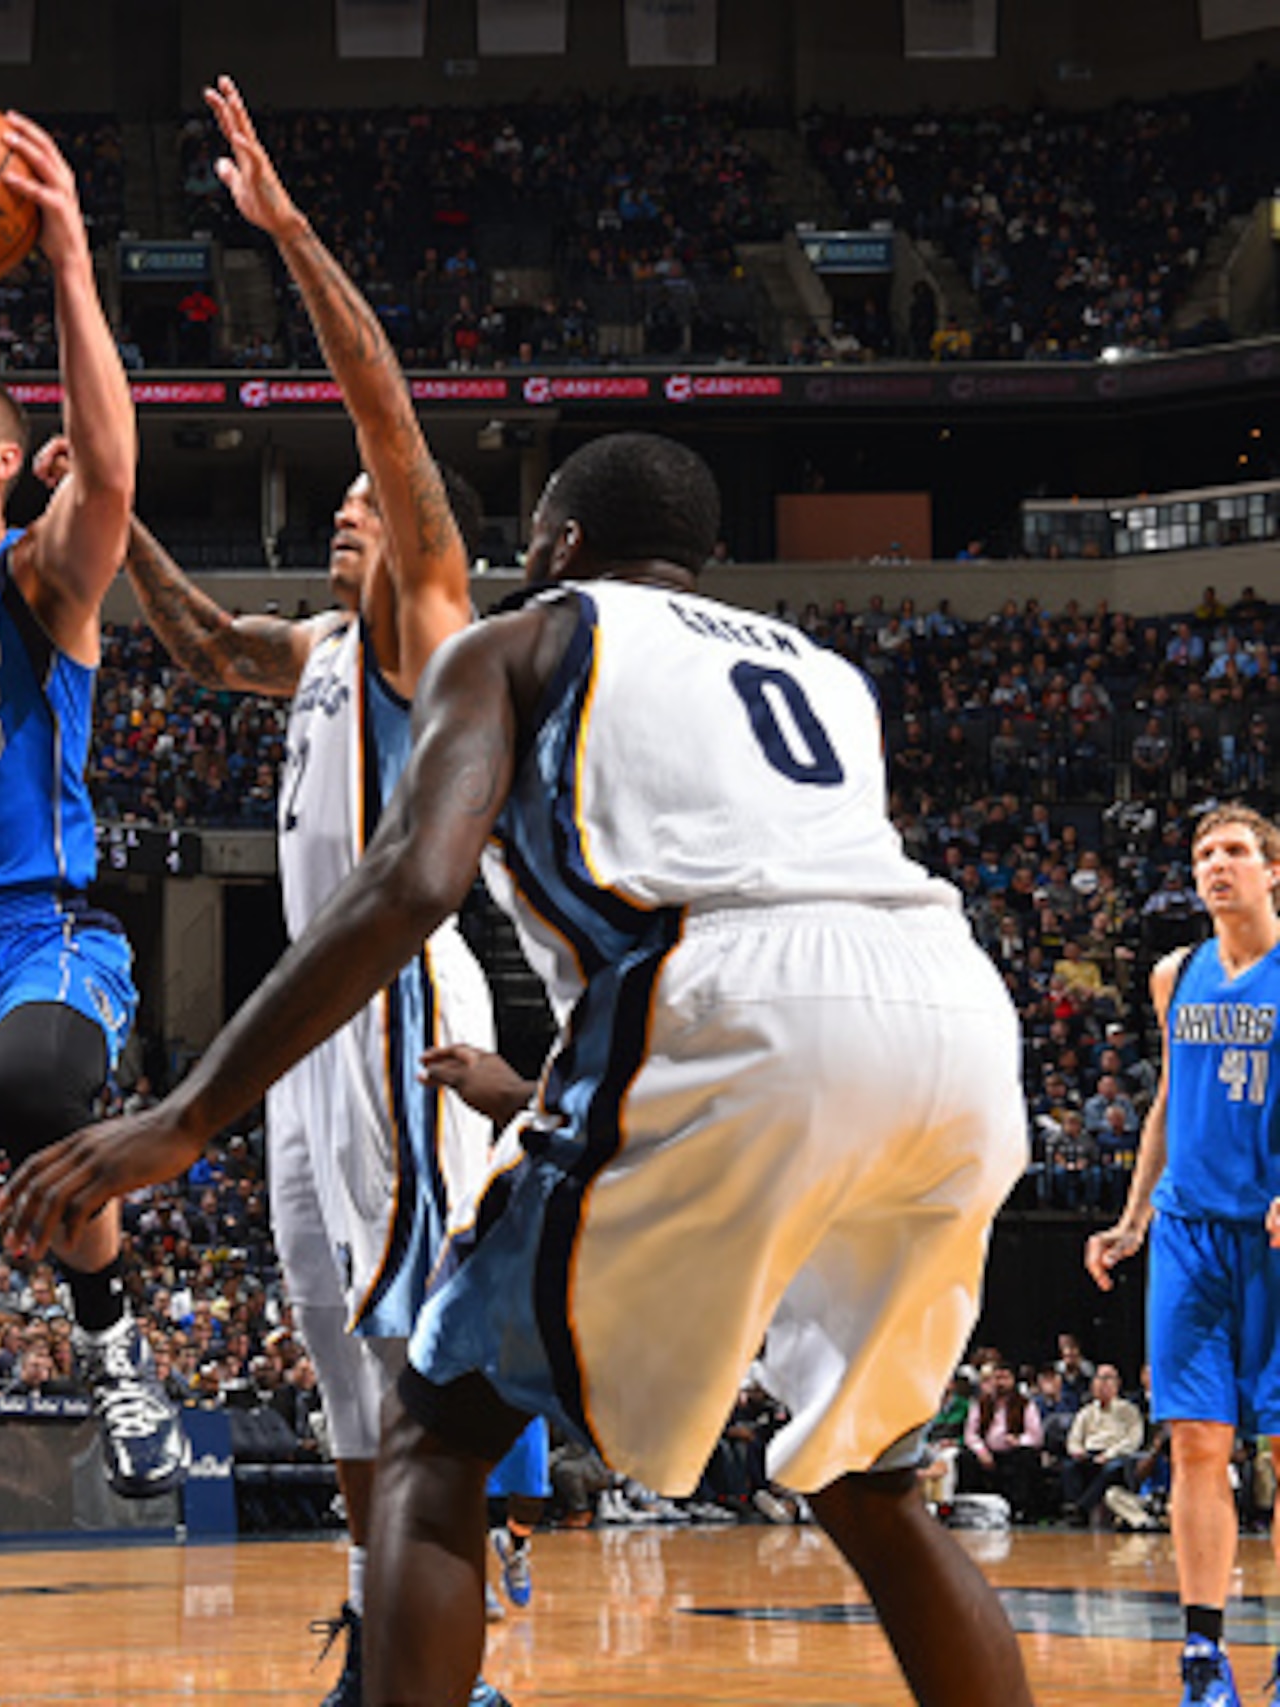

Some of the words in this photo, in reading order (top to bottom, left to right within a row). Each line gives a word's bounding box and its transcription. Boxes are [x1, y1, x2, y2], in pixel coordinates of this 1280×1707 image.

[668, 598, 803, 659] GREEN
[729, 659, 846, 787] 0
[1218, 1048, 1269, 1105] 41
